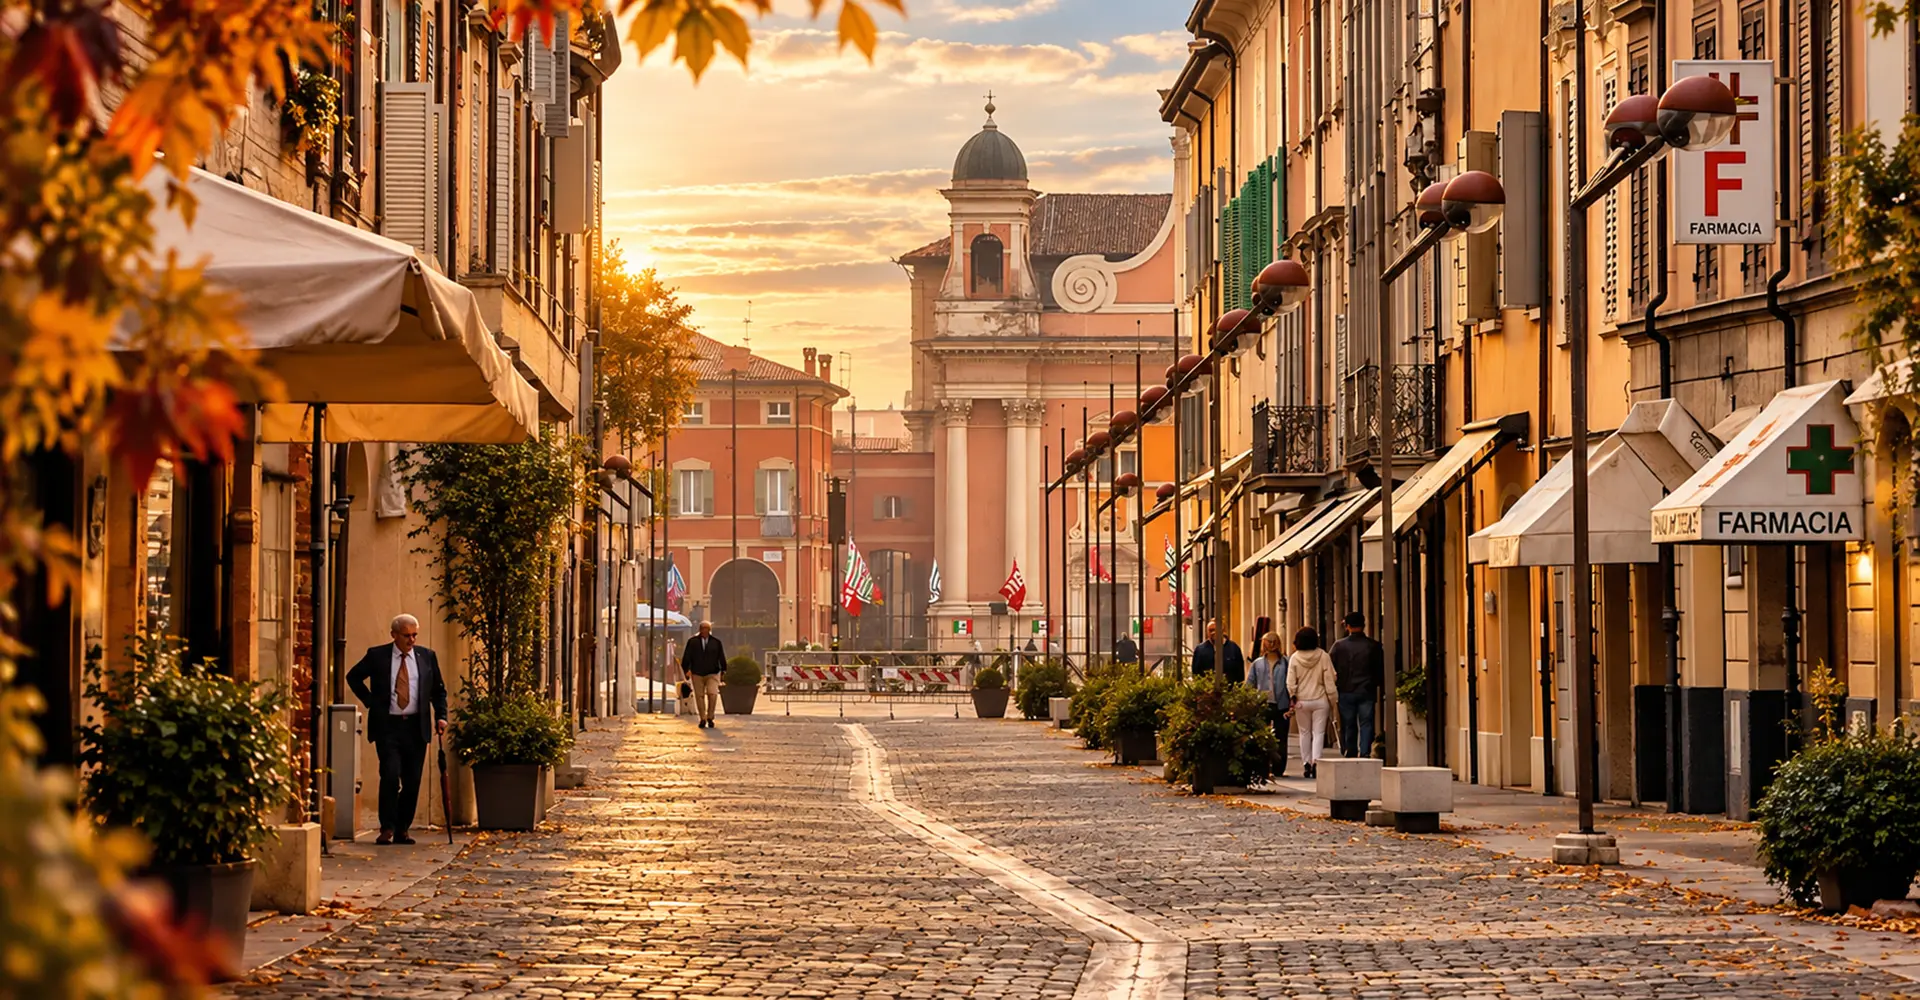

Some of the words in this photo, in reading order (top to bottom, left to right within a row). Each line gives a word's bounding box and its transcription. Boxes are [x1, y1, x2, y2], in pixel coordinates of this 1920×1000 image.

[1704, 151, 1746, 217] F
[1690, 222, 1762, 235] FARMACIA
[1718, 511, 1853, 534] FARMACIA
